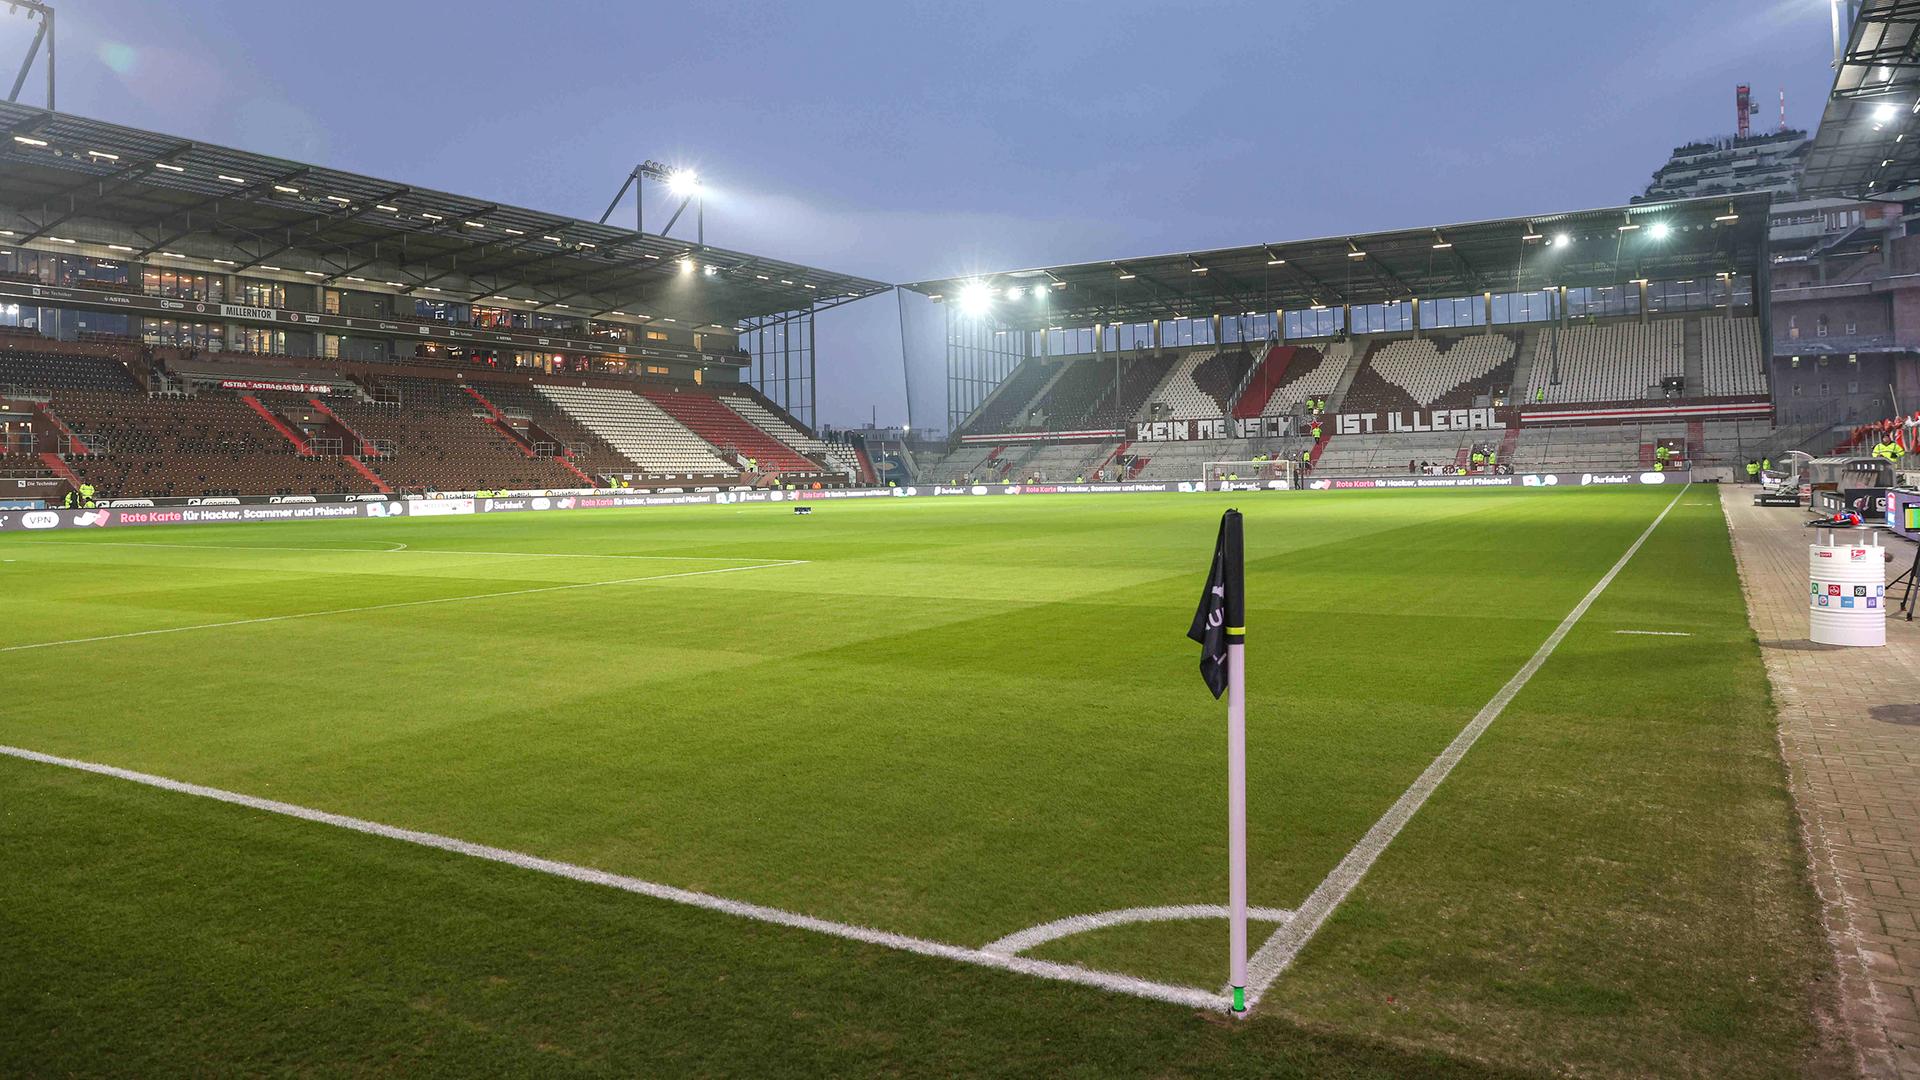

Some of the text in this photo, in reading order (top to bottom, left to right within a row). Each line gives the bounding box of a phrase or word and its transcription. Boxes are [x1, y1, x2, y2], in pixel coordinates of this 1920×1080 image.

[226, 306, 272, 319] MILLERNTOR
[1137, 420, 1188, 441] KEIN
[1336, 413, 1377, 434] IST
[1388, 408, 1506, 432] ILLEGAL
[29, 516, 52, 525] VPN
[120, 506, 357, 523] Rote Karte für Hacker, Scammer und Phischer!
